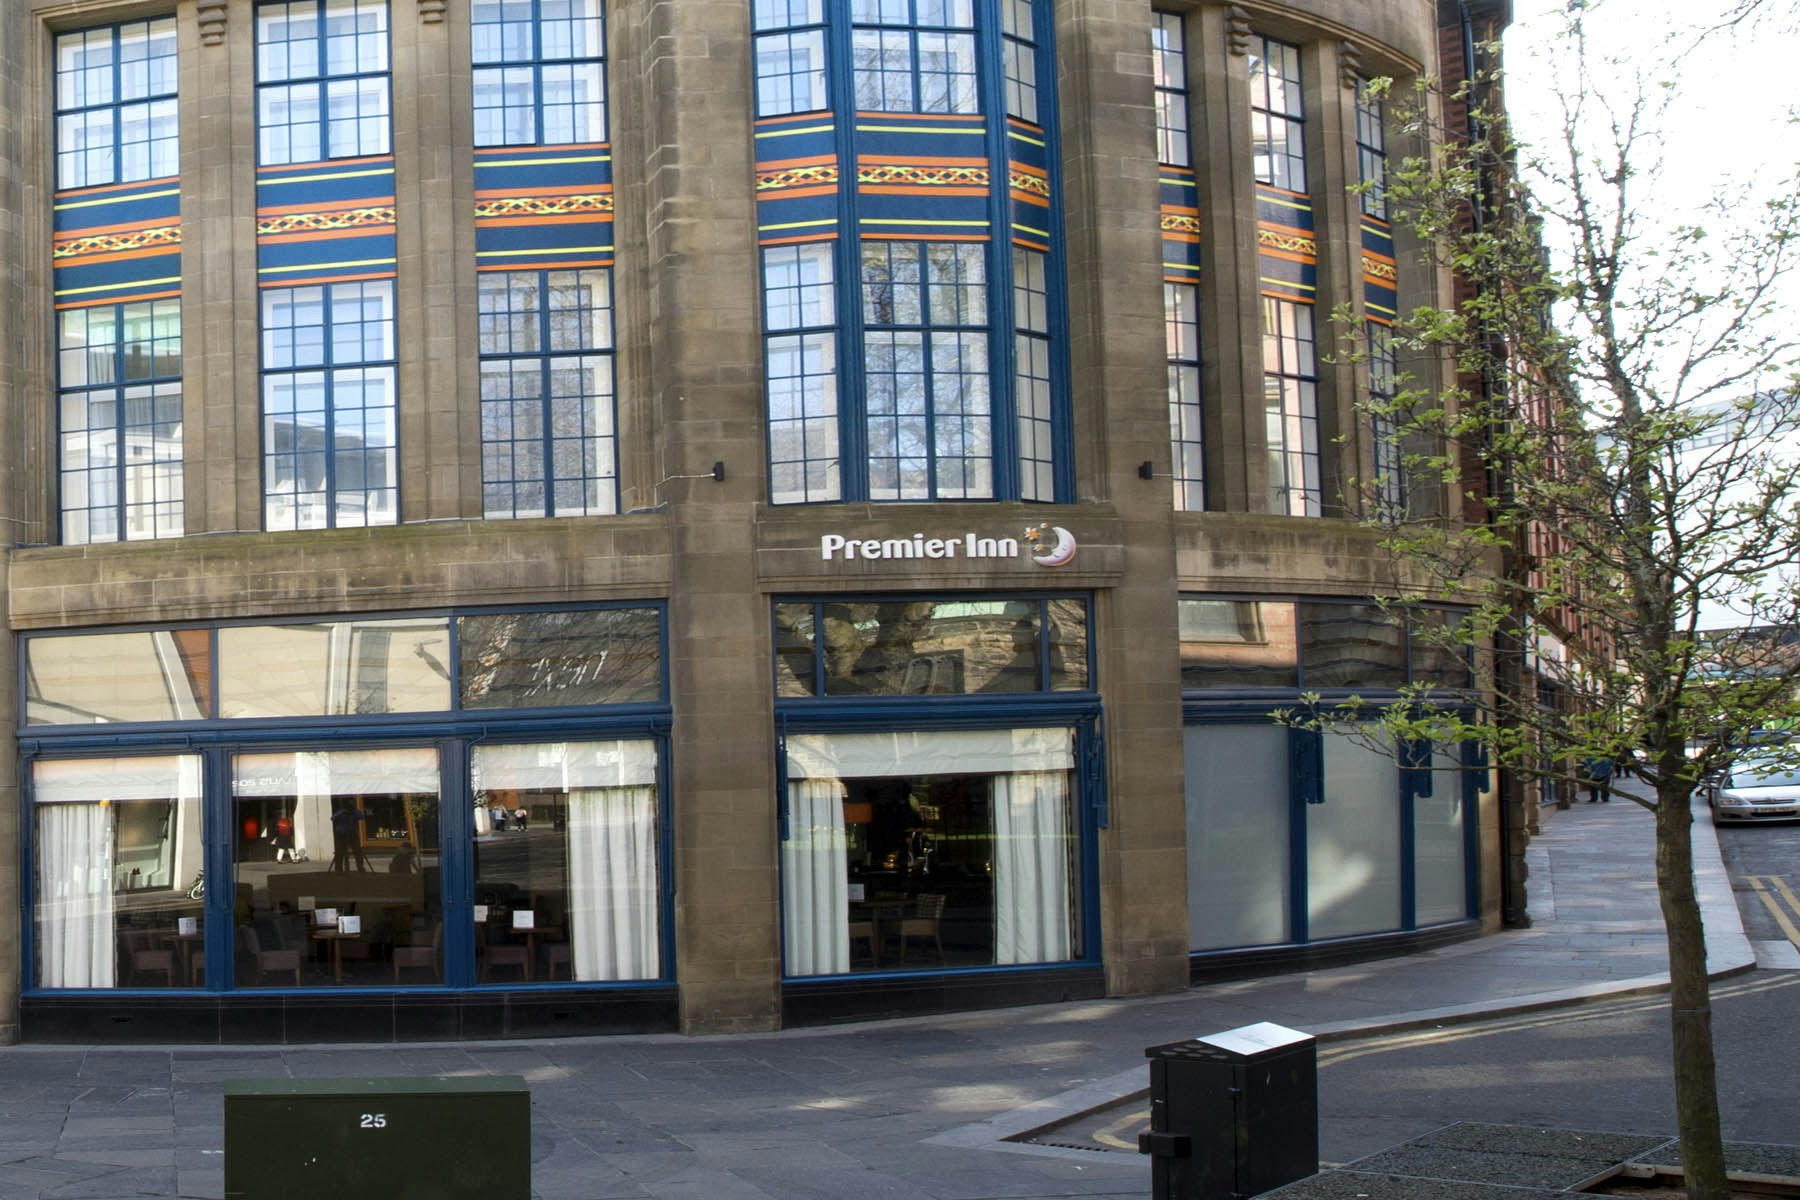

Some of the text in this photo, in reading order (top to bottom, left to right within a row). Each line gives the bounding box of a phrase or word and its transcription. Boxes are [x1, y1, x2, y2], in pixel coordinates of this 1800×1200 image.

[821, 533, 1018, 560] Premier Inn
[360, 1113, 387, 1128] 25
